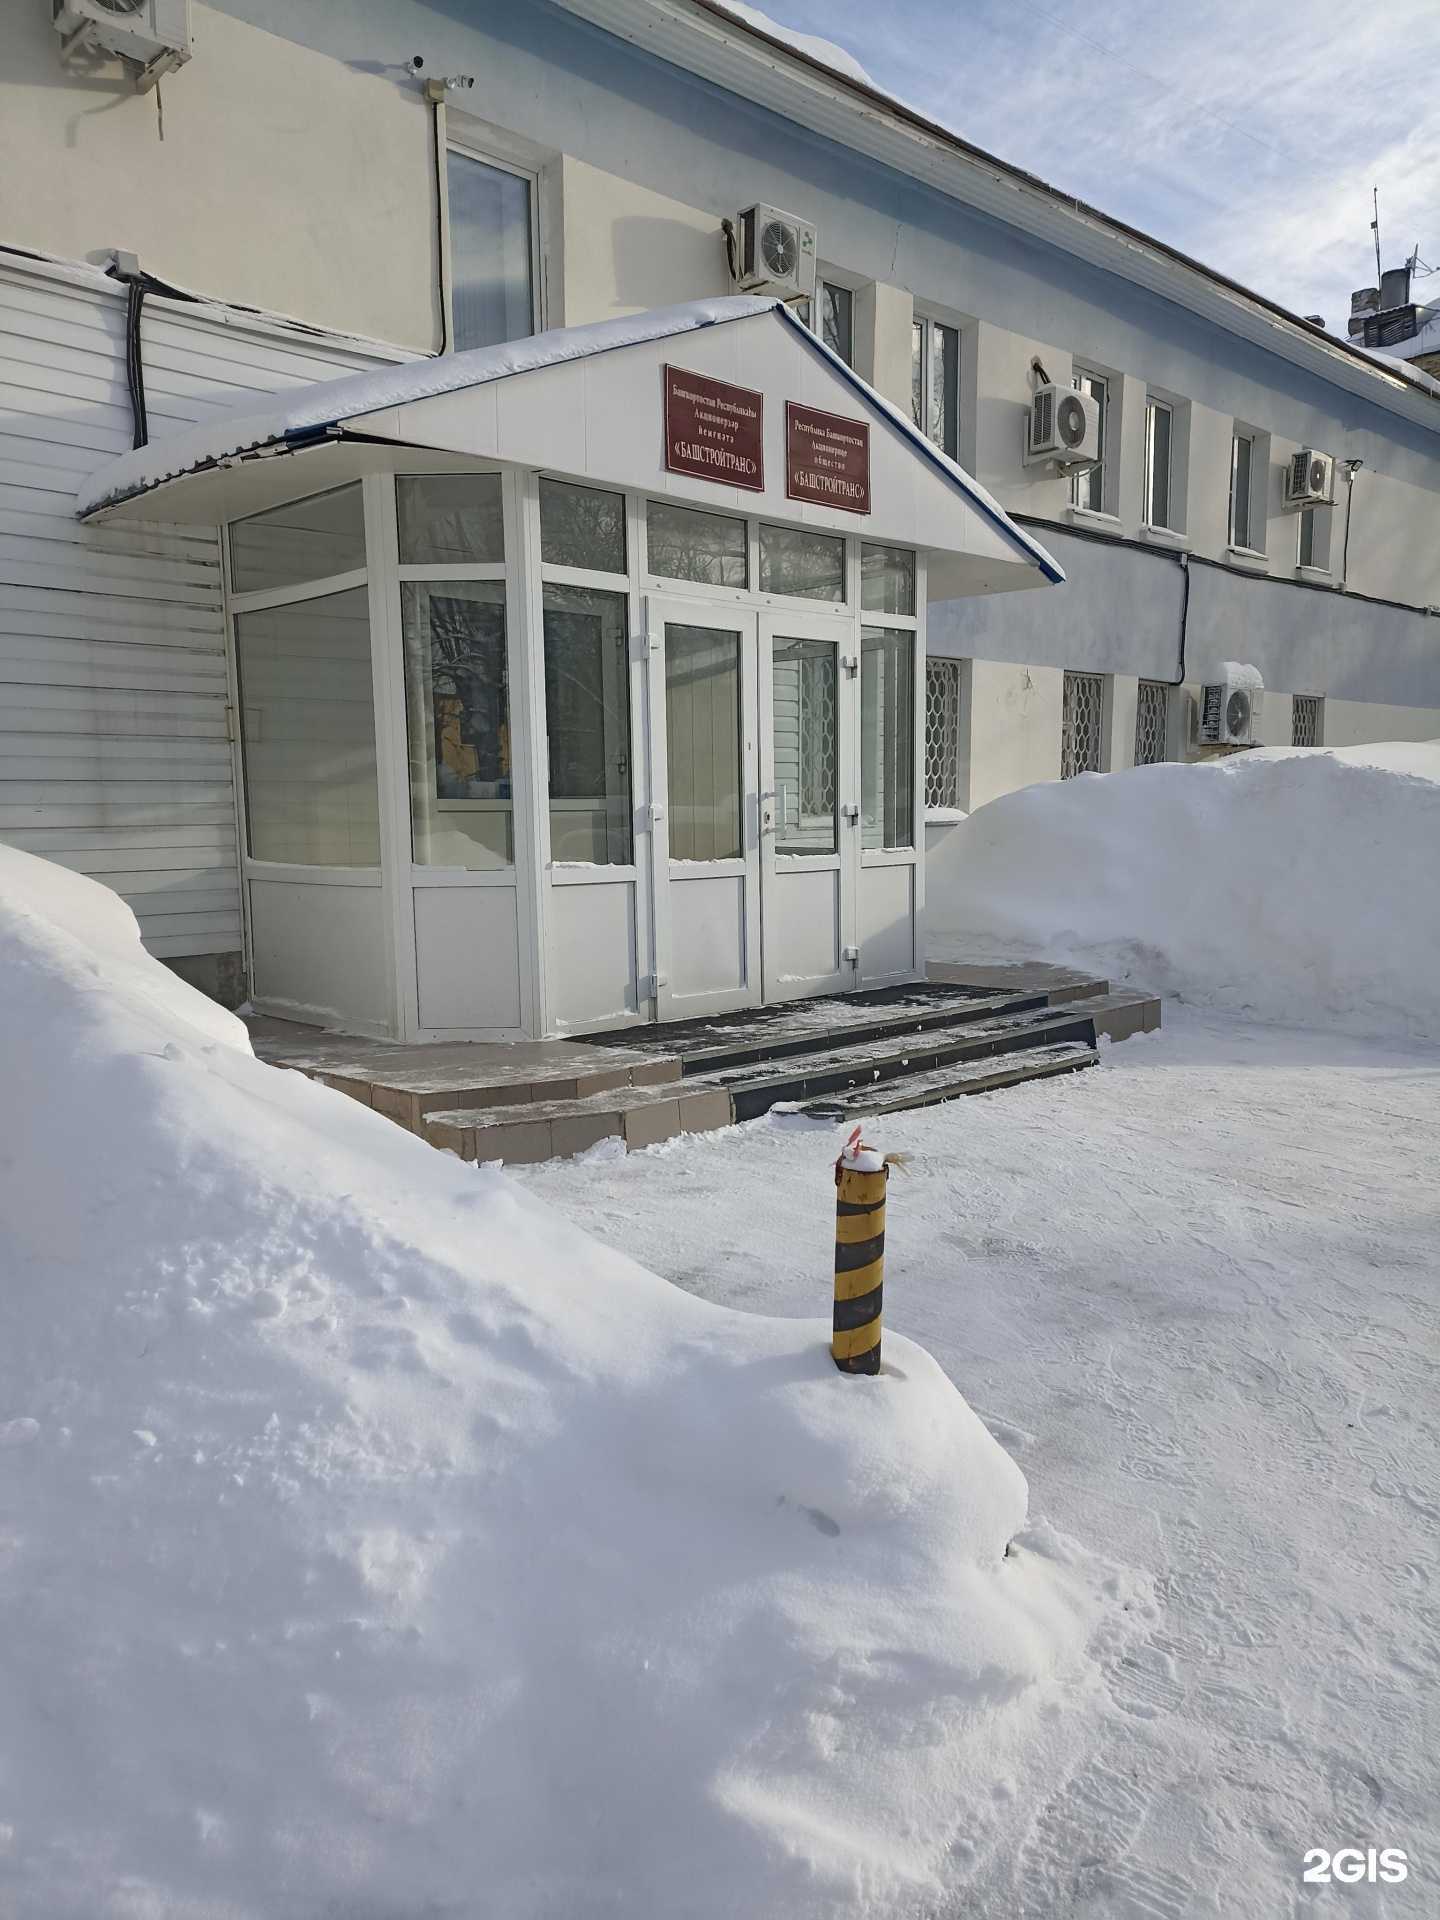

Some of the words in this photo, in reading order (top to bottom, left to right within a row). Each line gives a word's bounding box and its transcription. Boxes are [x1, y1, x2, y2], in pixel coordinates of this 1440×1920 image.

[794, 419, 826, 438] Республика
[674, 441, 757, 475] «БАШСТРОЙТРАНС»
[814, 455, 846, 471] общество
[794, 471, 865, 498] «БАШСТРОЙТРАНС»
